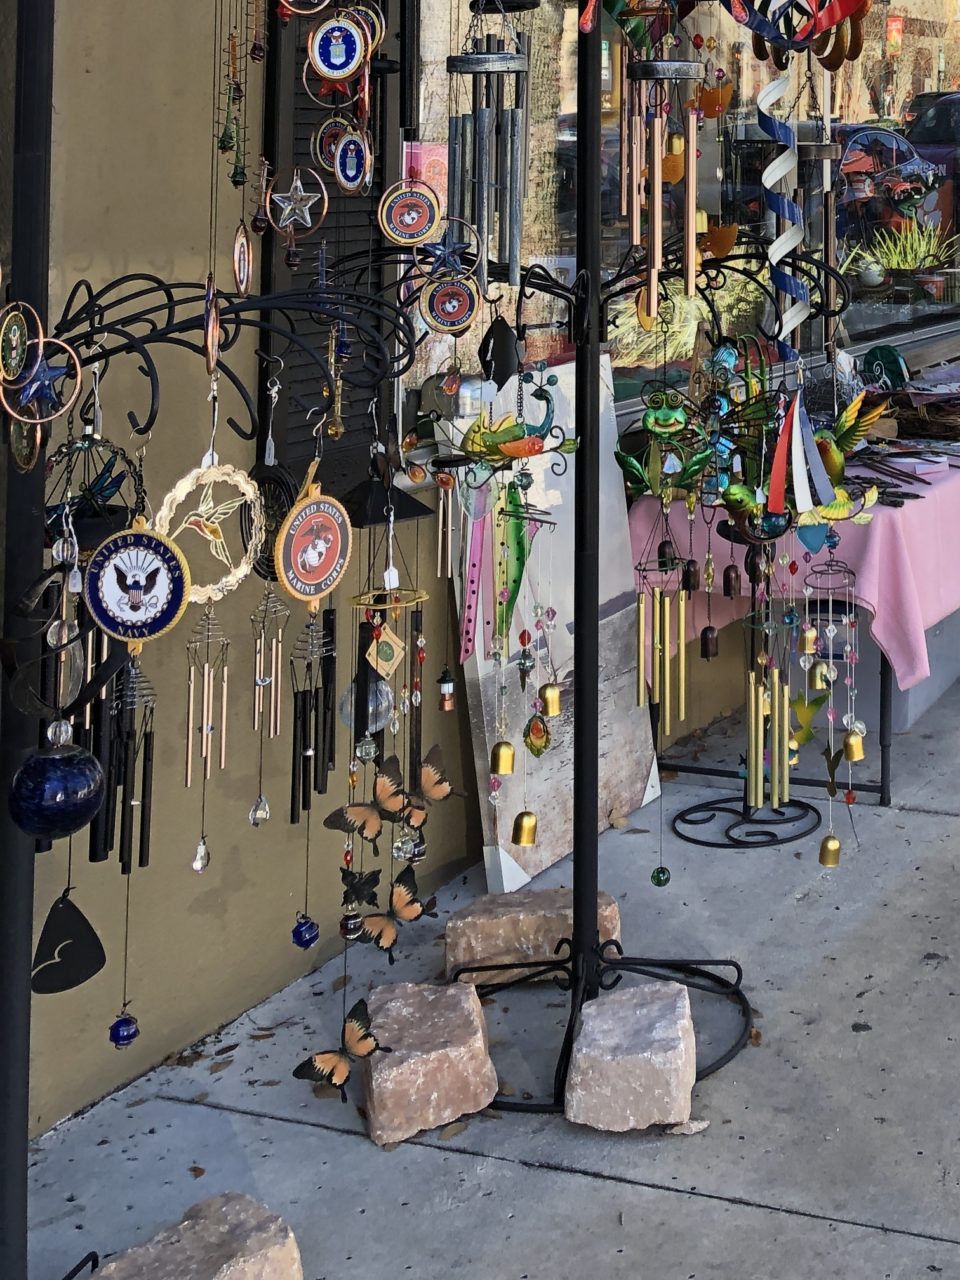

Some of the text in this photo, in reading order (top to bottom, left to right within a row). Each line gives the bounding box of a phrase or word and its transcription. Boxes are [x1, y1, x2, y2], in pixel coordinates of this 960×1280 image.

[390, 192, 430, 207] UNITED STATES
[389, 223, 431, 238] MARINE CORPS
[289, 503, 343, 535] UNITED STATES
[90, 536, 180, 578] UNITED STATES
[287, 558, 345, 594] MARINE CORPS
[116, 626, 151, 637] NAVY
